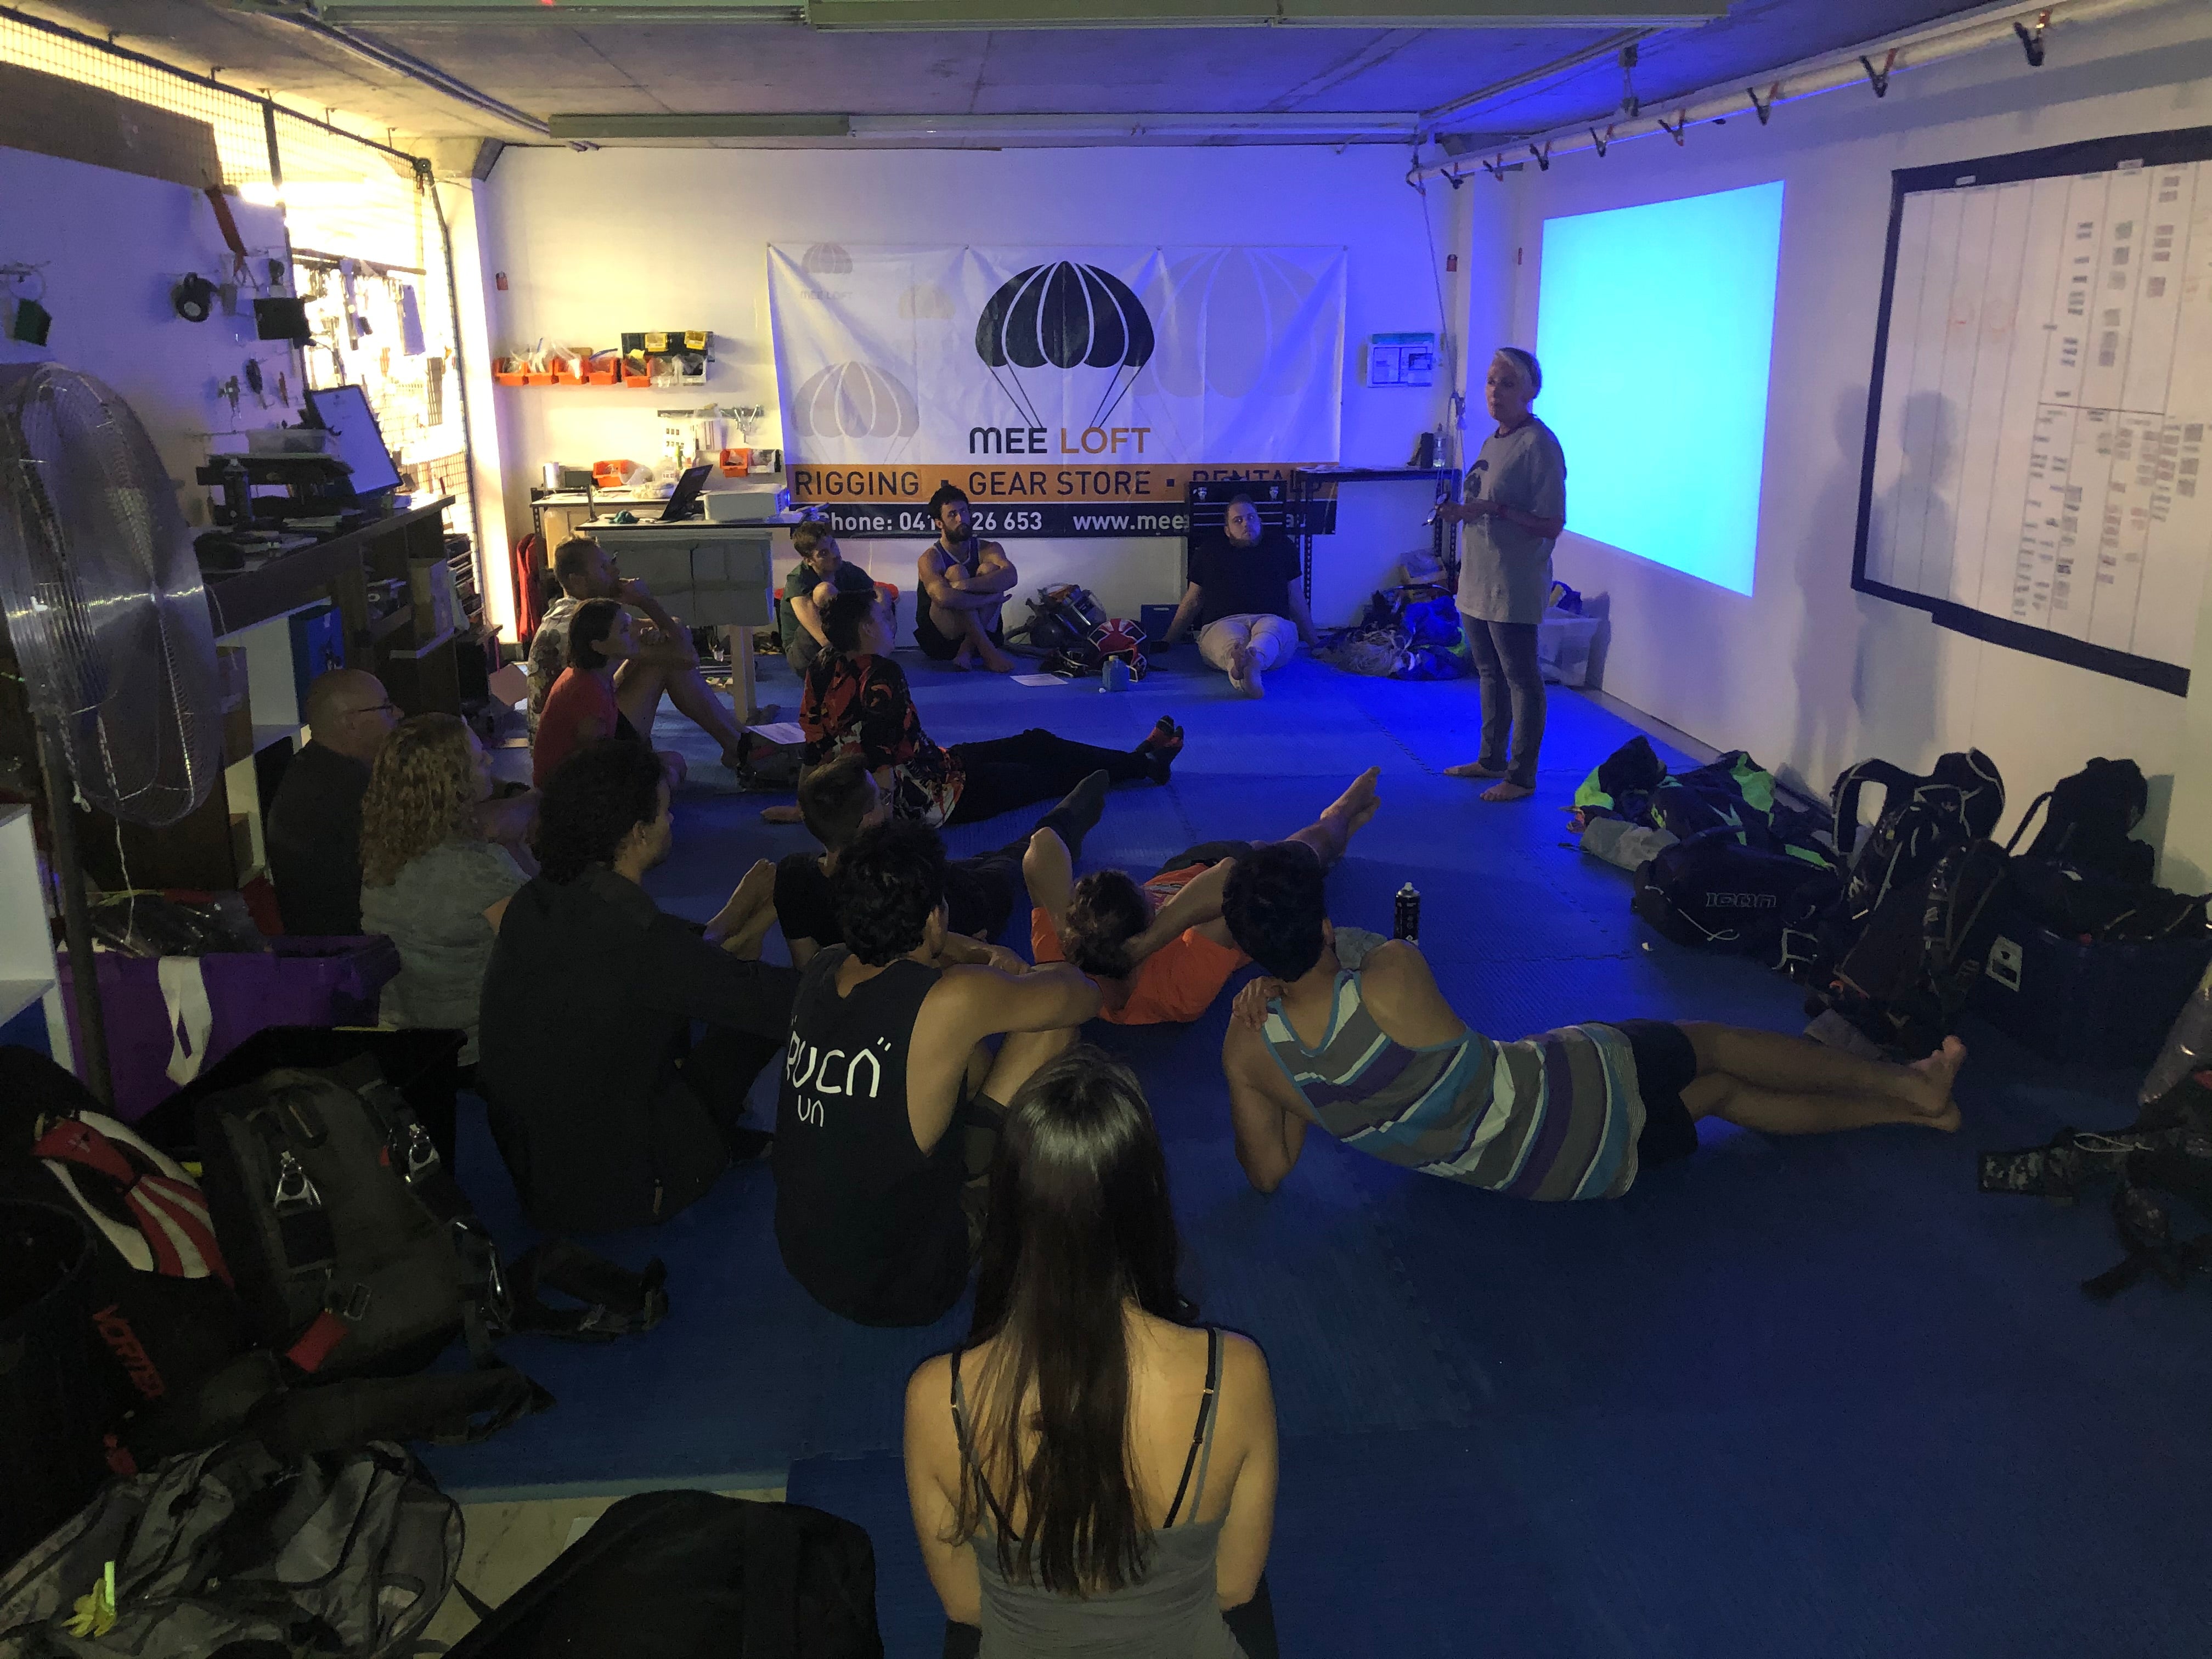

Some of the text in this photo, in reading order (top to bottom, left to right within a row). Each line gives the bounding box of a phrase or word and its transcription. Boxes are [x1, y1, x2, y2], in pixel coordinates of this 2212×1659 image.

[969, 427, 1150, 454] MEE LOFT
[794, 471, 919, 495] RIGGING
[969, 471, 1048, 495] GEAR
[1057, 470, 1150, 495] STORE
[1004, 512, 1042, 531] 653
